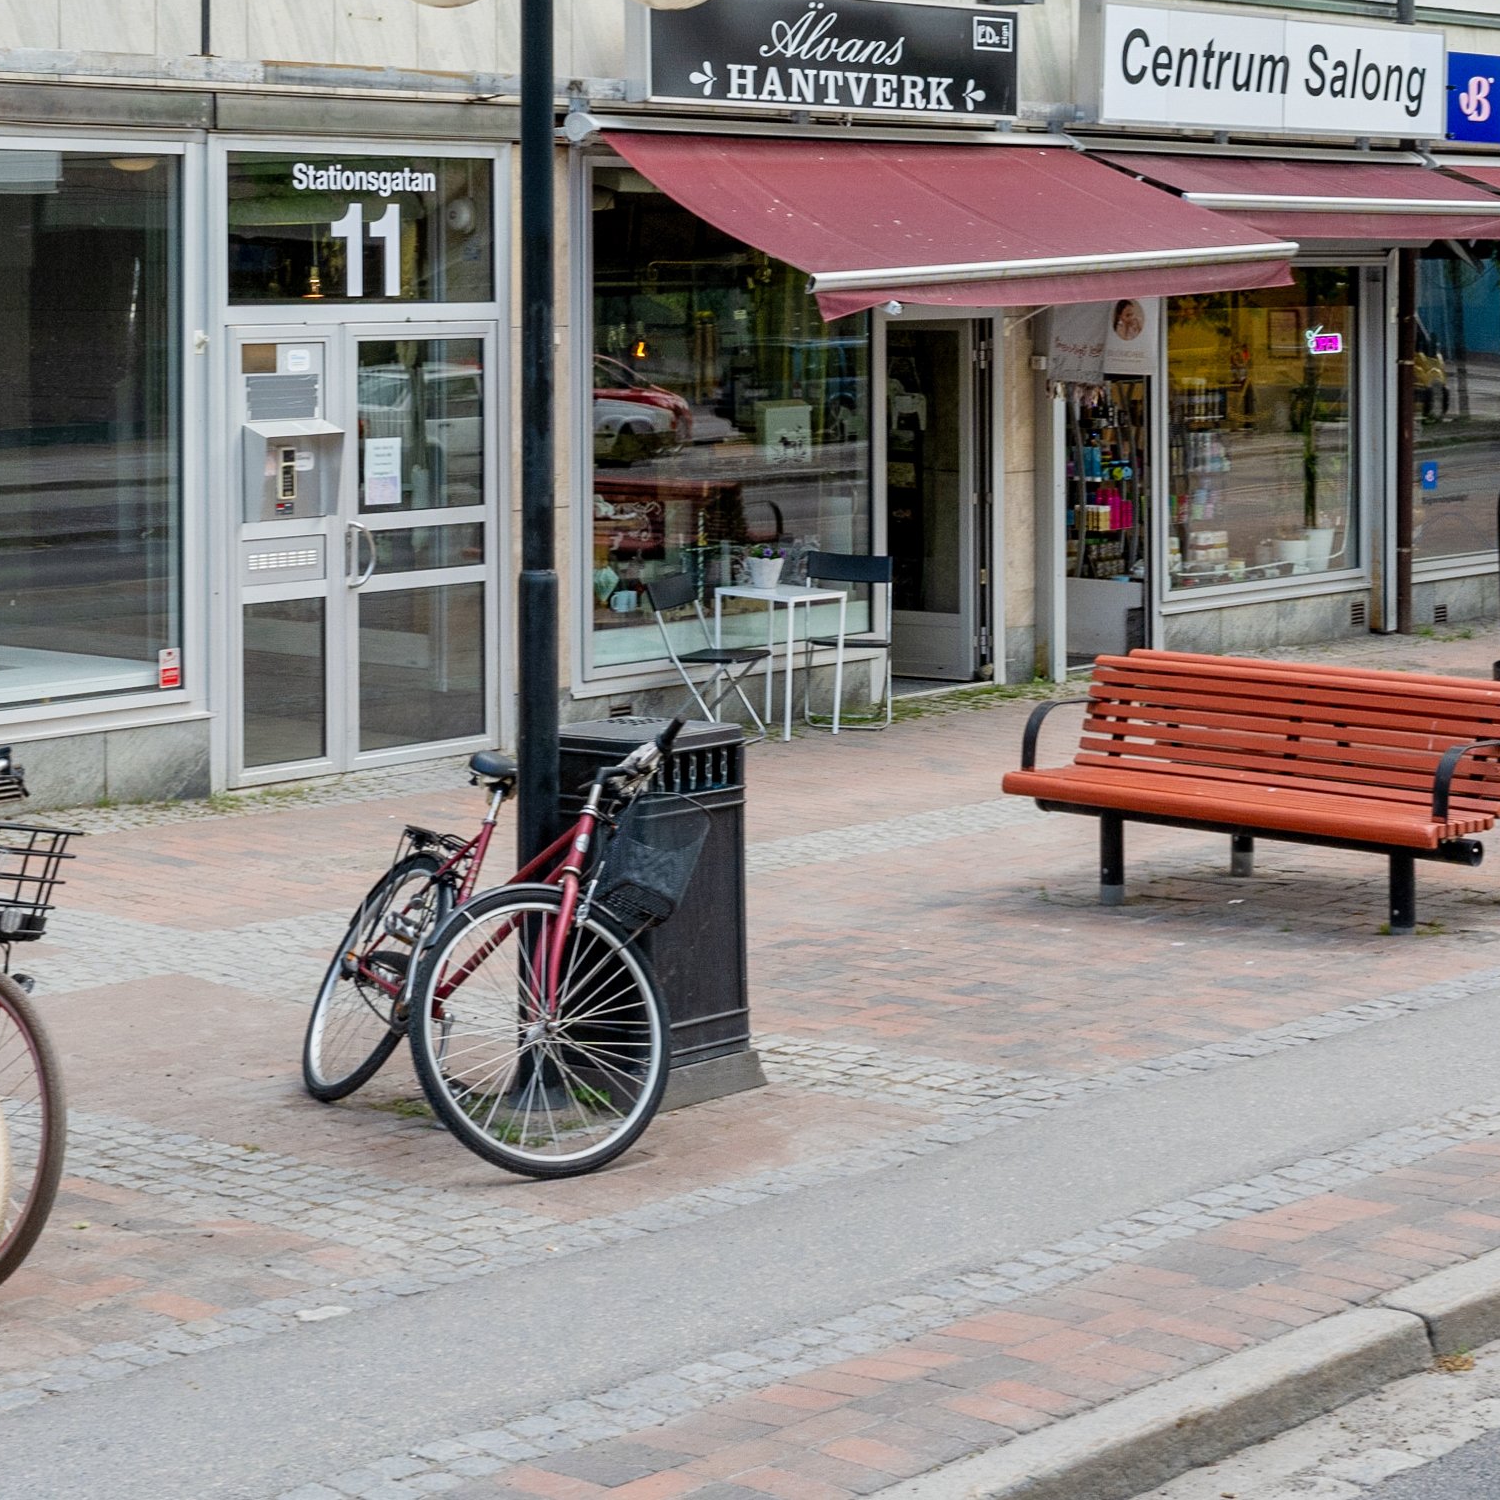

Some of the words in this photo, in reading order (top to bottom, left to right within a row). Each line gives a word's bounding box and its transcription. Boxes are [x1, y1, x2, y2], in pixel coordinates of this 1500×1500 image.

[759, 1, 906, 67] Älvans
[726, 63, 955, 112] HANTVERK
[1121, 27, 1290, 94] Centrum
[1304, 43, 1426, 118] Salong
[292, 163, 437, 197] Stationsgatan
[331, 203, 401, 297] 11
